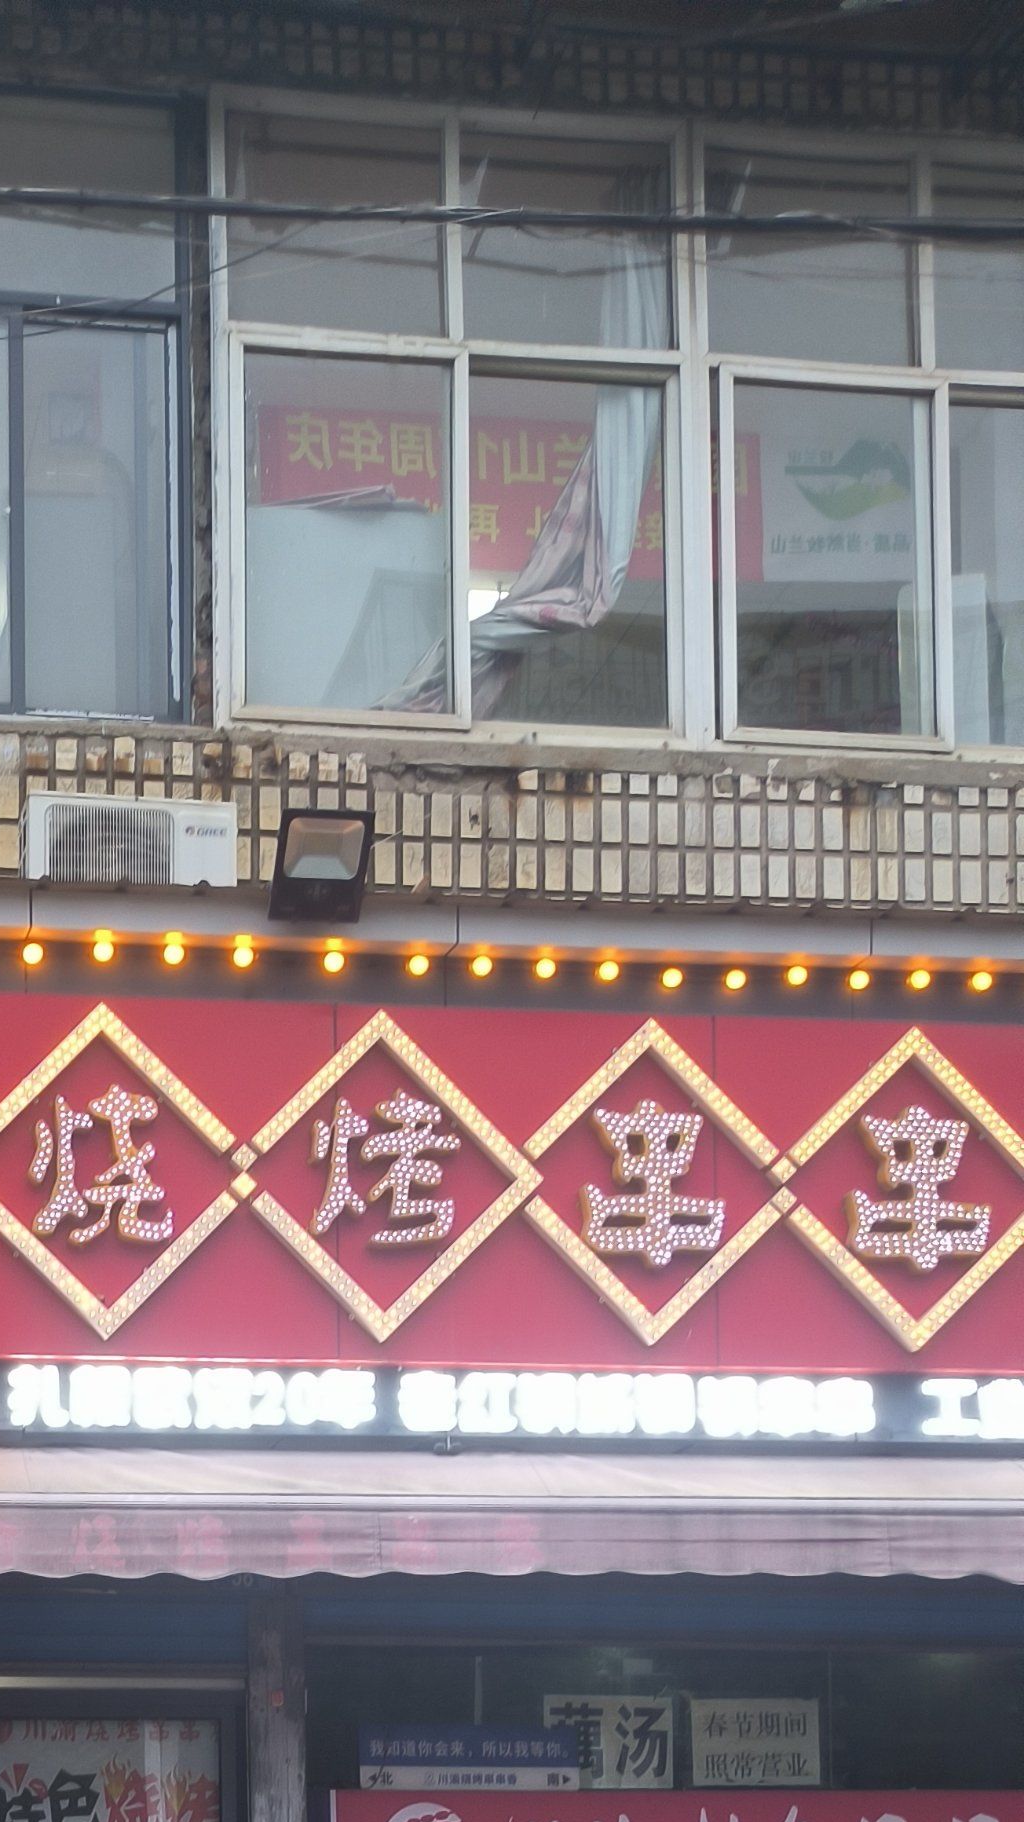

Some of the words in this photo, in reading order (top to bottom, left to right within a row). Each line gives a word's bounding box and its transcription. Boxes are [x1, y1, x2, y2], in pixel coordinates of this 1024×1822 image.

[26, 1082, 993, 1274] 烧烤串串
[704, 1711, 808, 1739] 春节期间
[704, 1752, 809, 1781] 照常营业
